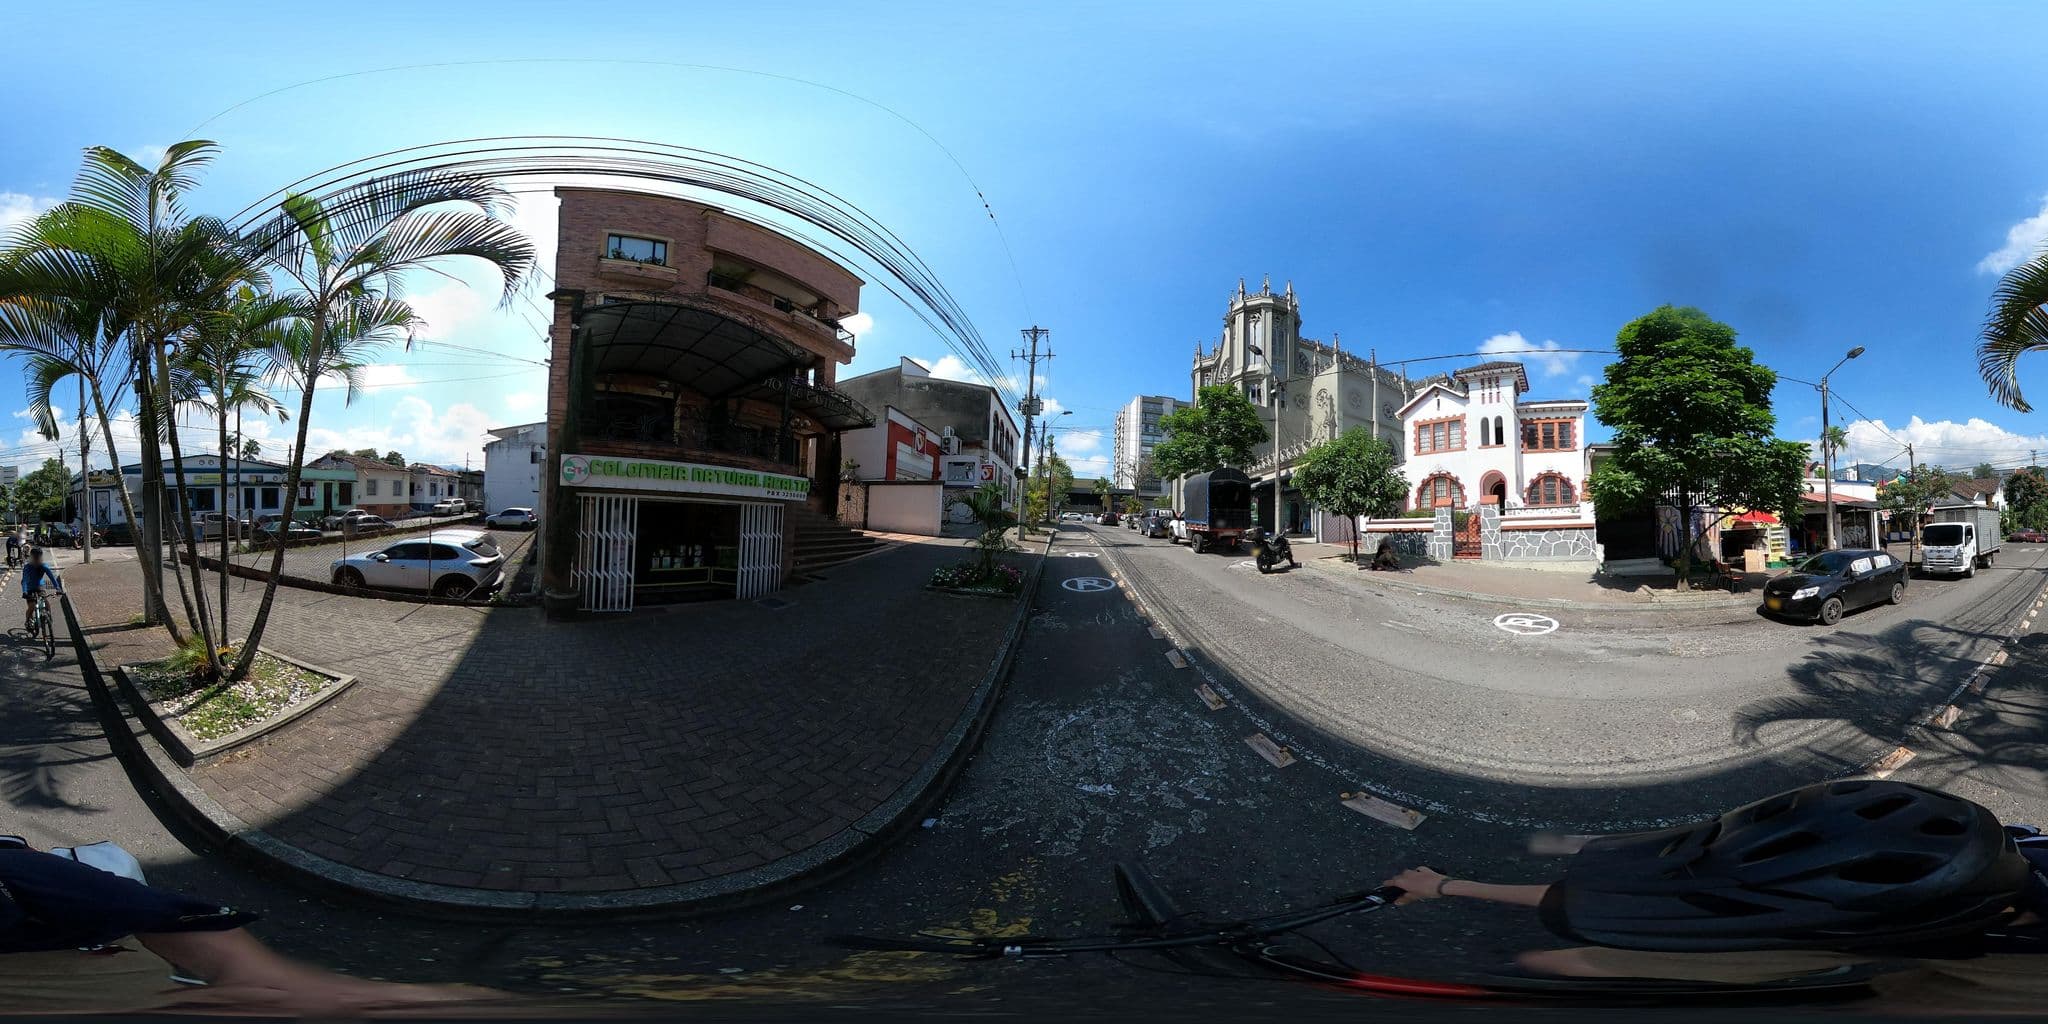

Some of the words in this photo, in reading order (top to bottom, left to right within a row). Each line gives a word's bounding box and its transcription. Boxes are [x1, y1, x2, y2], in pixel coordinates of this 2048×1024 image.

[590, 459, 688, 481] COLOMBIA
[691, 467, 761, 488] NATURAL
[763, 475, 811, 492] HEALTH
